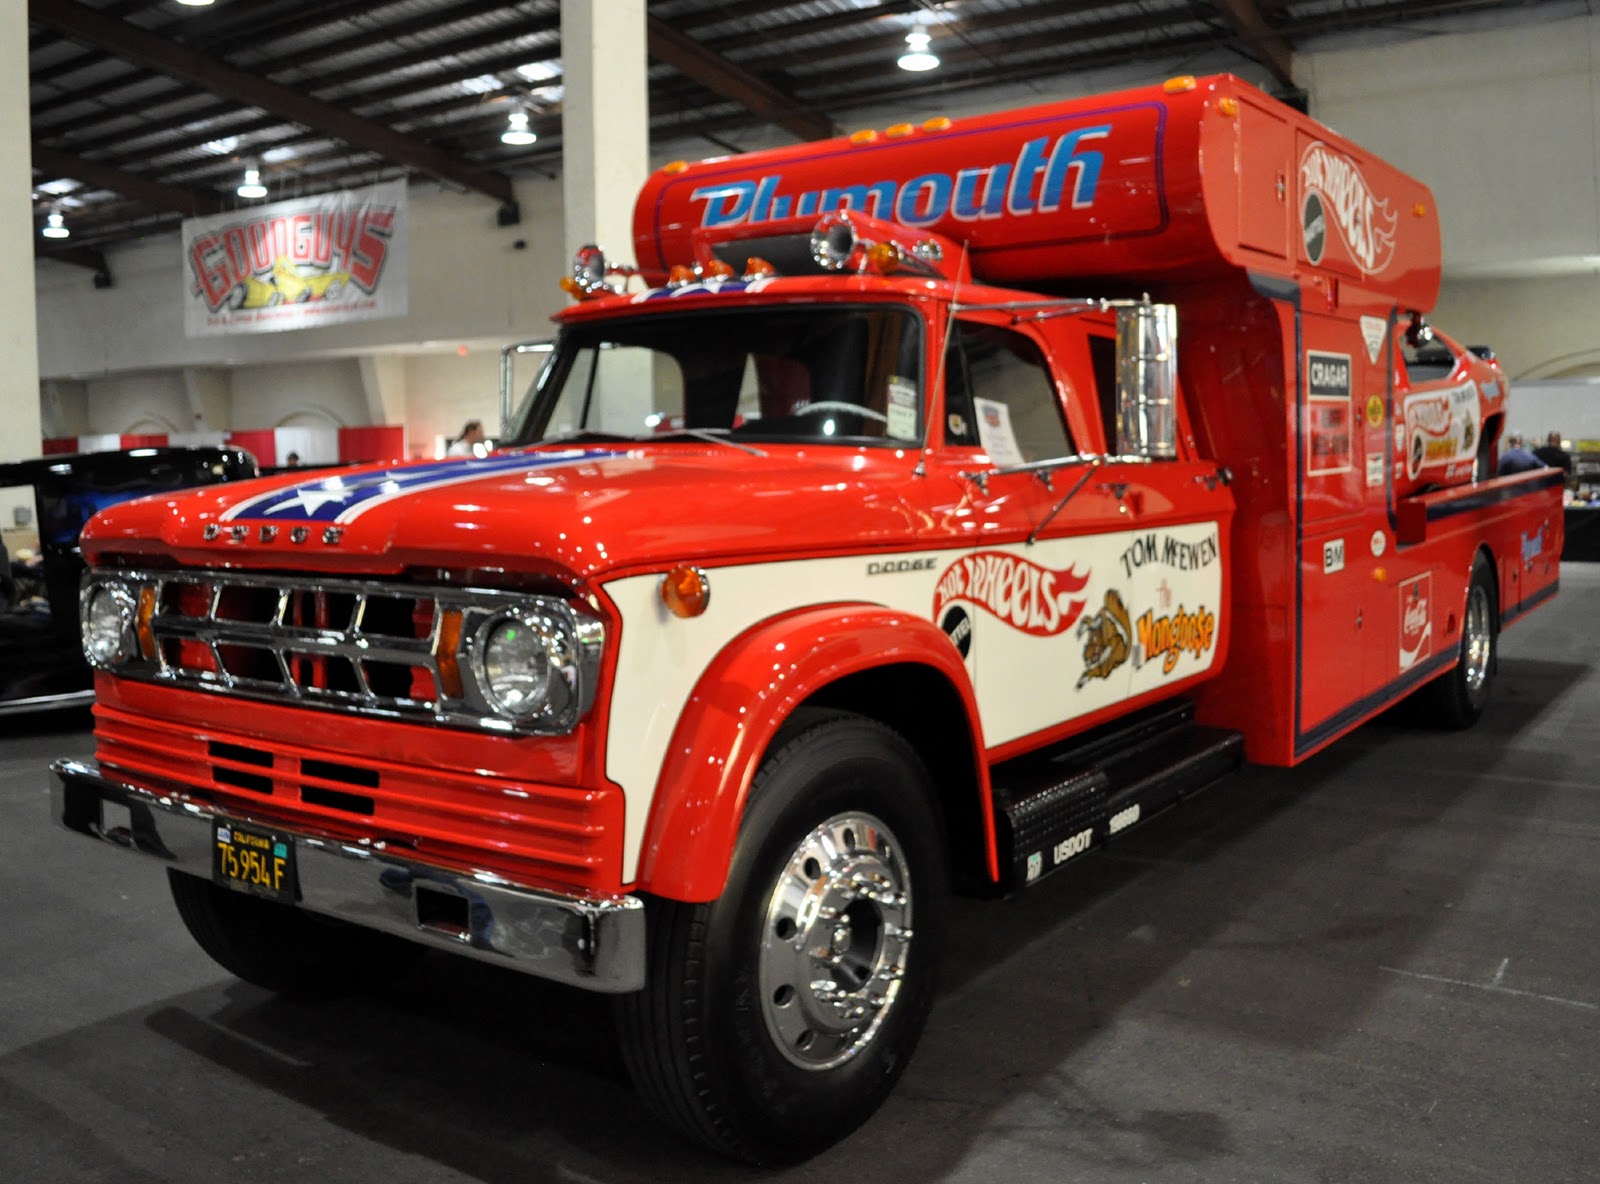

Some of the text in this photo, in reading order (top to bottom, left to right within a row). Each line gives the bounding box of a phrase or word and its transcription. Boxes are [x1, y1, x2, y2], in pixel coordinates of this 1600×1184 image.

[1311, 362, 1348, 388] CRAGAR
[867, 557, 938, 575] DODGE
[1120, 533, 1158, 578] TOM
[1136, 603, 1214, 675] Mongoose
[1053, 828, 1094, 865] USDOT
